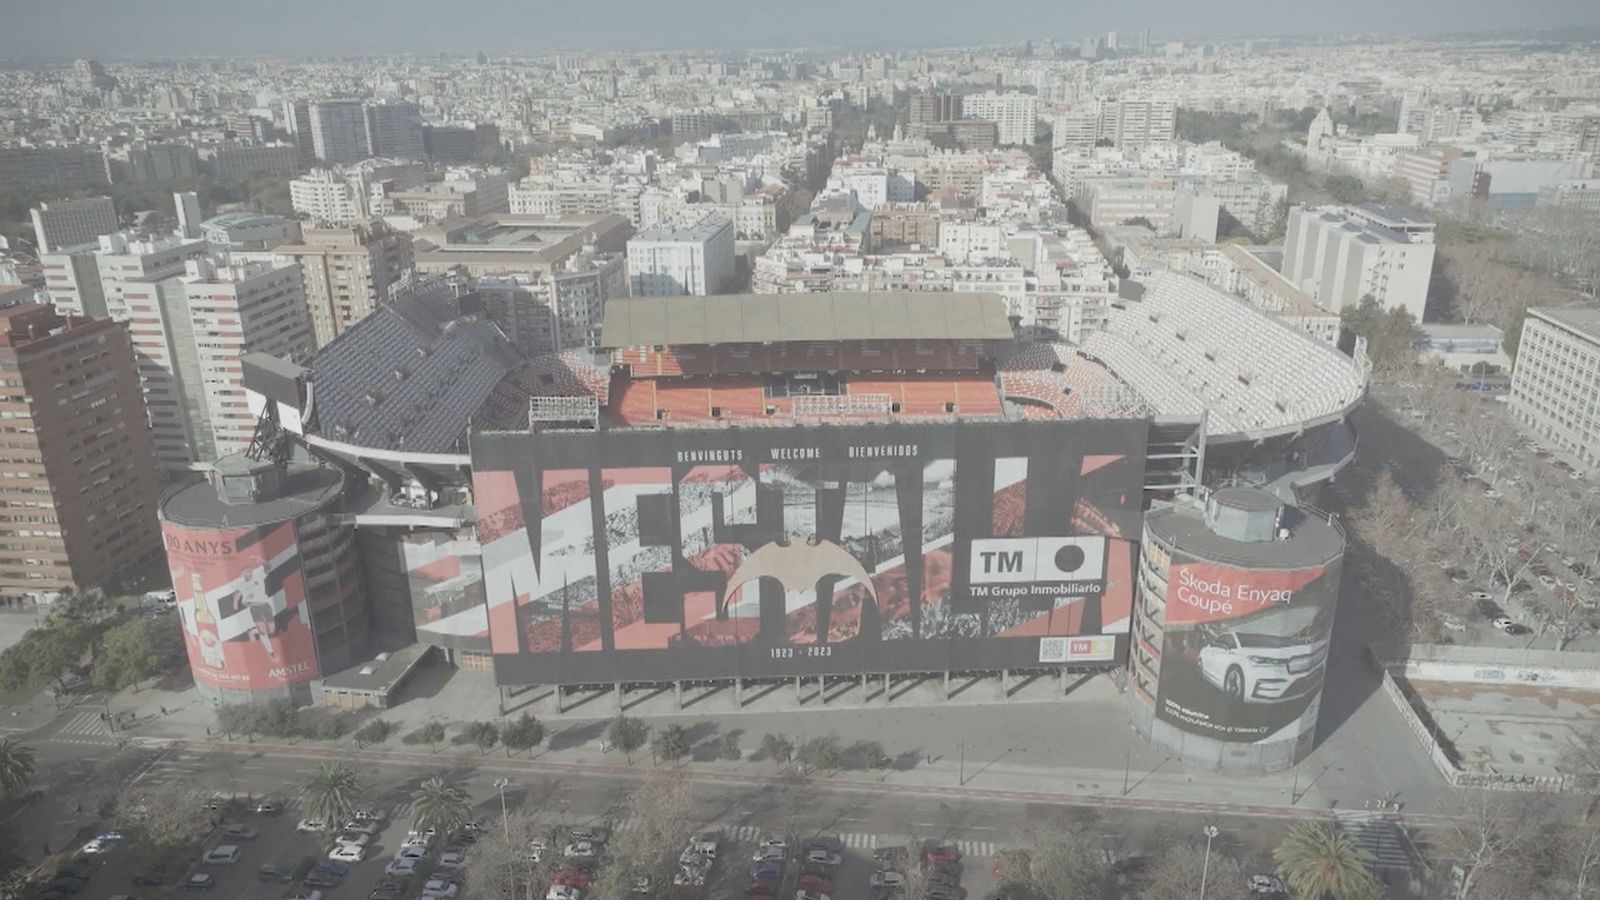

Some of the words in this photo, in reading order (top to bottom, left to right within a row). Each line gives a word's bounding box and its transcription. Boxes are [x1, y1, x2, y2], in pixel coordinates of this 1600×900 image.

[677, 449, 743, 462] BENVINGUTS
[770, 447, 820, 460] WELCOME
[848, 445, 918, 458] BIENVENIDOS
[184, 540, 233, 555] ANYS
[980, 551, 1023, 573] TM
[970, 587, 988, 597] TM
[992, 586, 1028, 598] Grupo
[1031, 584, 1101, 595] Inmobiliario
[1179, 565, 1231, 597] Škoda
[1237, 585, 1292, 604] Enyaq
[1177, 587, 1233, 614] Coupé
[770, 648, 793, 659] 1923
[808, 646, 832, 657] 2023
[1073, 642, 1088, 652] TM
[269, 662, 310, 678] AMSTEL
